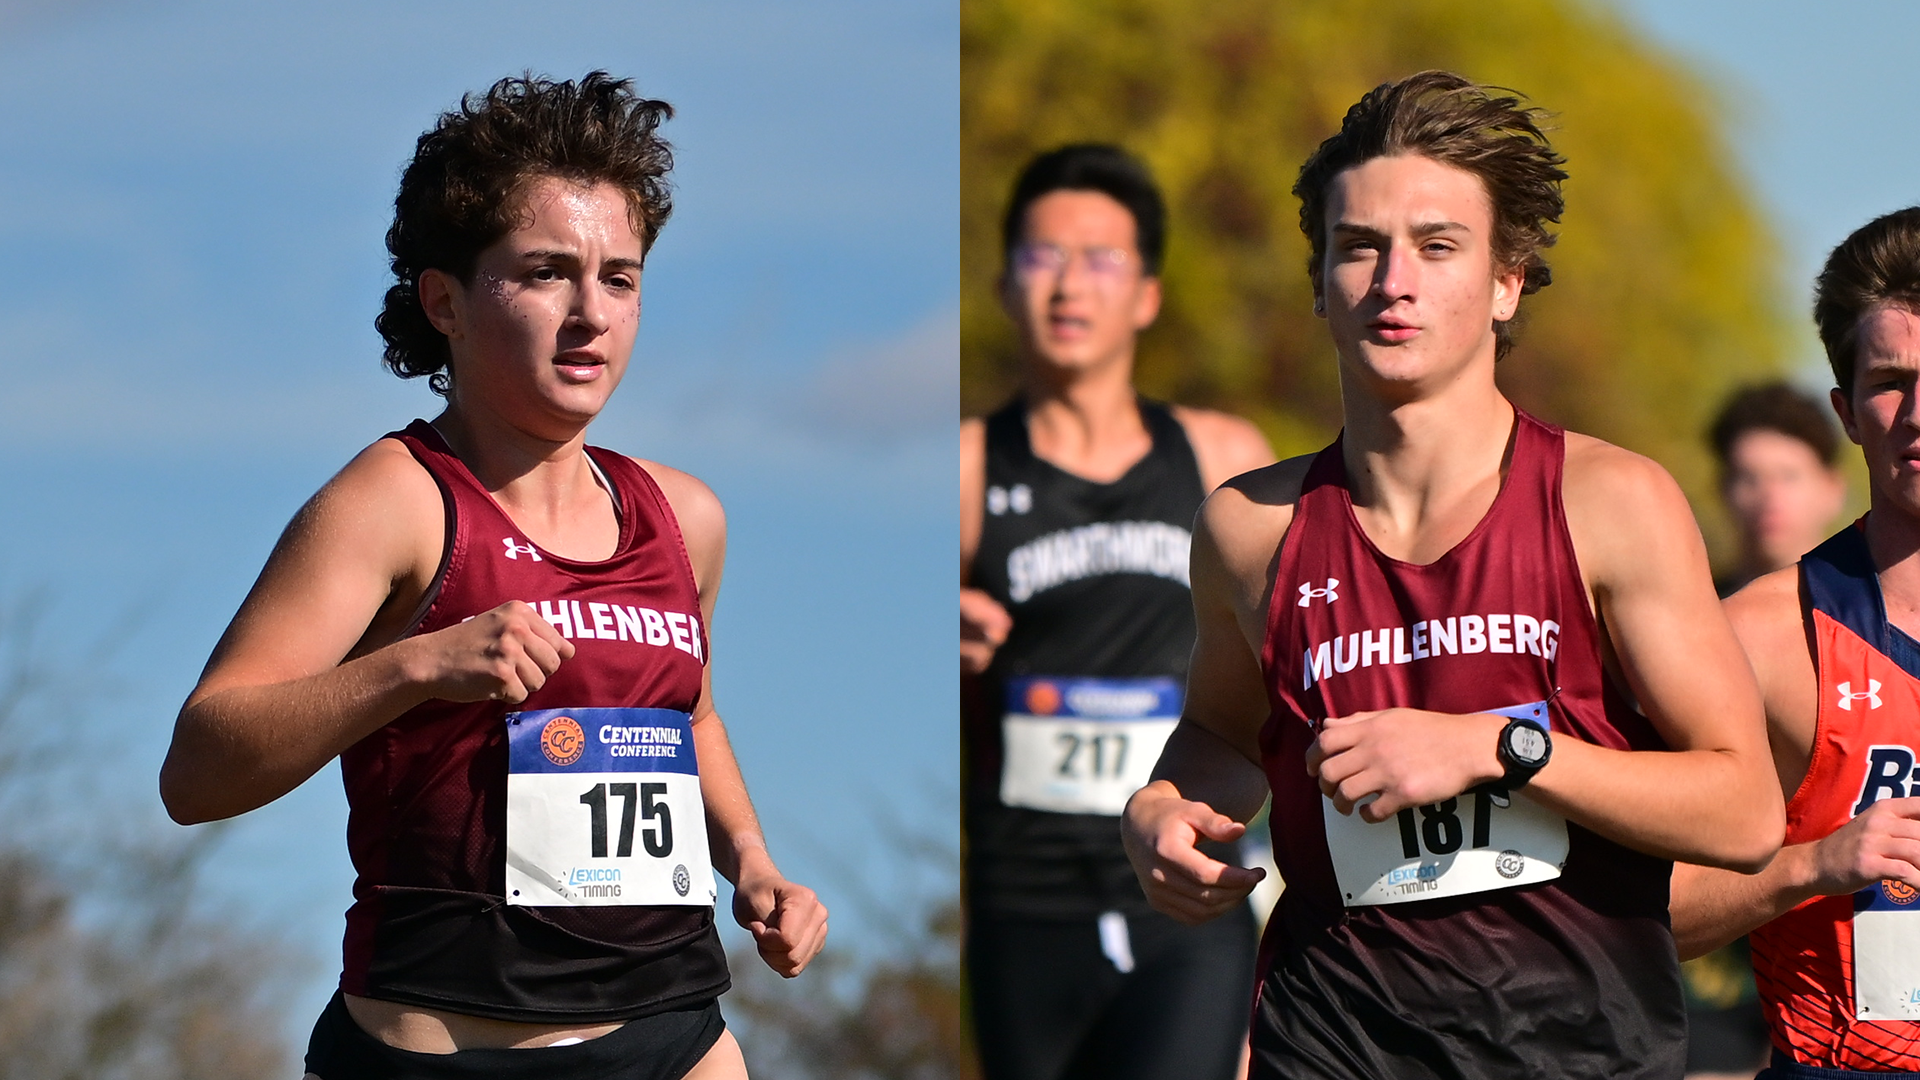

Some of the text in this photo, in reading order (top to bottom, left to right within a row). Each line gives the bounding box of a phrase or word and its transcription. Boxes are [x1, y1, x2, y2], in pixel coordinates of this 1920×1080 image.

[1303, 613, 1561, 691] MUHLENBERG
[550, 730, 576, 754] CC
[598, 724, 682, 745] CENTENNIAL
[610, 744, 678, 758] CONFERENCE
[1056, 732, 1130, 779] 217
[580, 782, 673, 858] 175
[1397, 788, 1493, 859] 187
